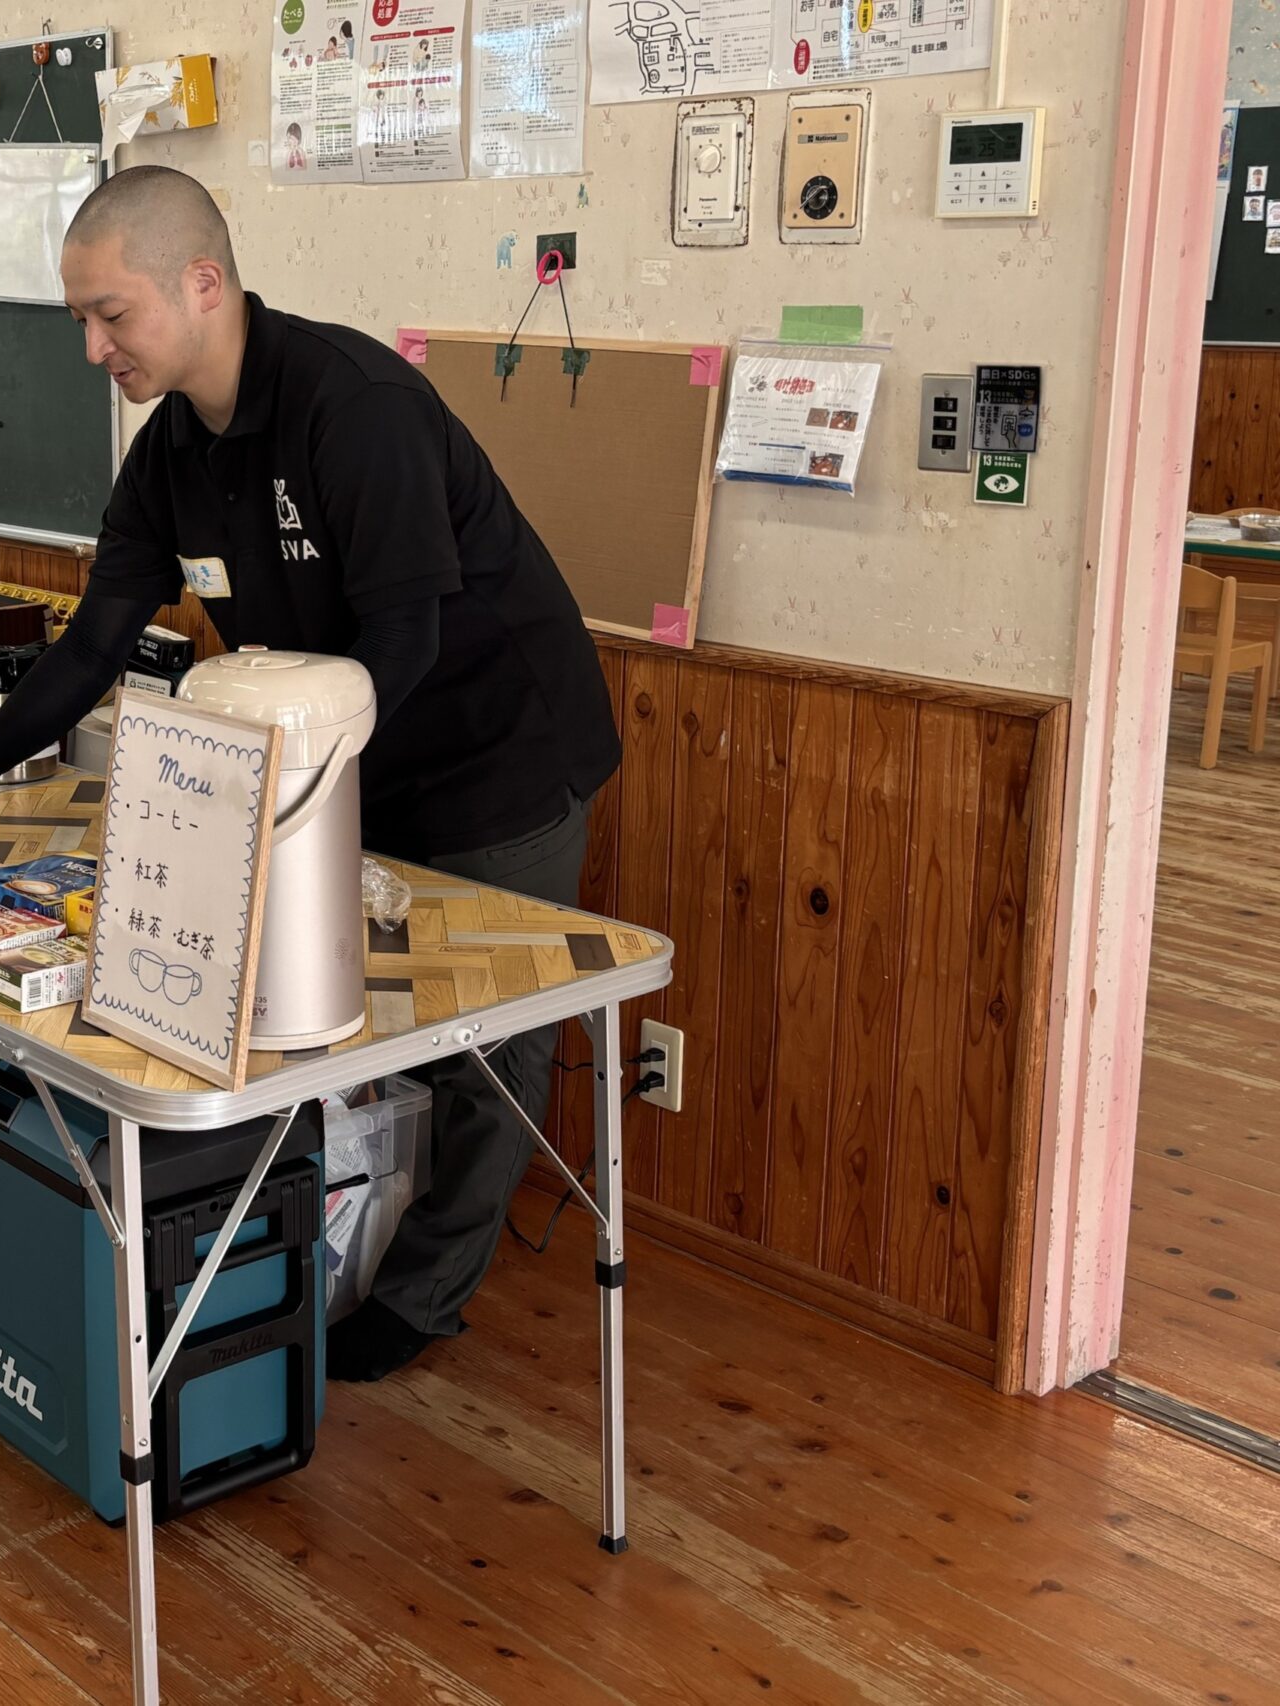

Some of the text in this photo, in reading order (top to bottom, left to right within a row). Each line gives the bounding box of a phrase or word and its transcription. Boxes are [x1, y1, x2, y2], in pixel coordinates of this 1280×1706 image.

[283, 8, 302, 19] たべる
[823, 30, 838, 42] 自宅
[978, 142, 996, 158] 25
[983, 454, 992, 466] 13
[280, 538, 321, 561] SVA
[158, 753, 215, 797] Menu
[134, 857, 169, 889] 紅茶
[128, 907, 164, 939] 緑茶
